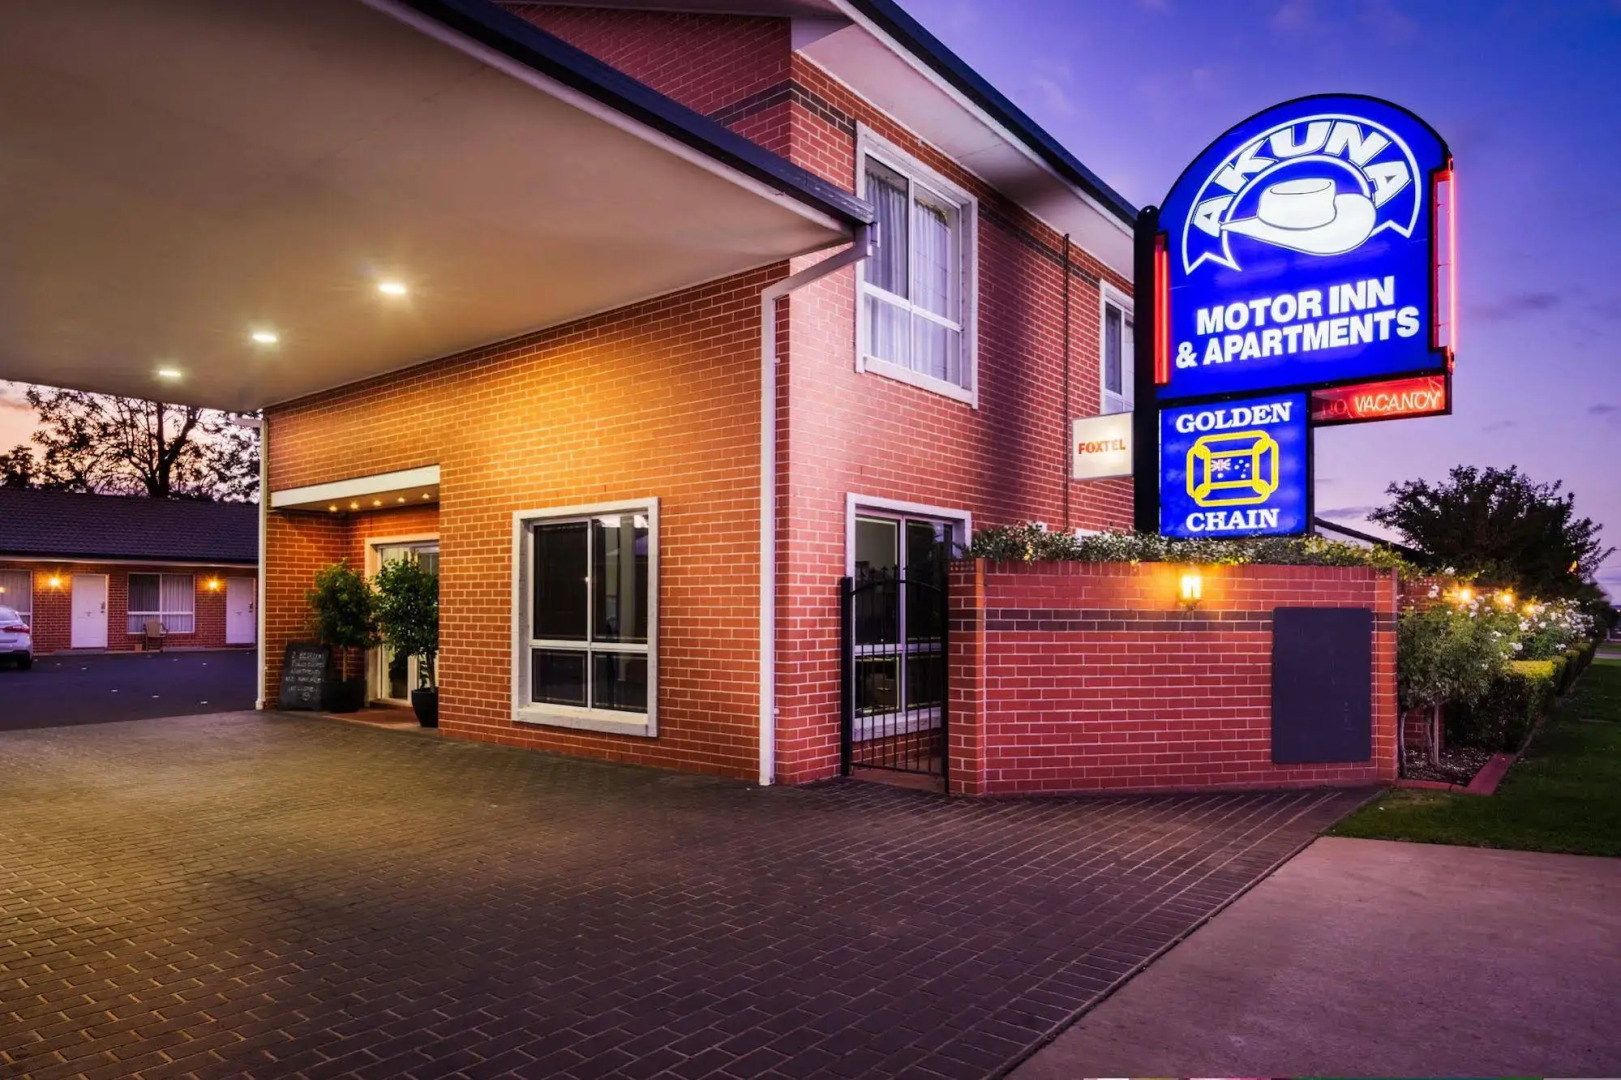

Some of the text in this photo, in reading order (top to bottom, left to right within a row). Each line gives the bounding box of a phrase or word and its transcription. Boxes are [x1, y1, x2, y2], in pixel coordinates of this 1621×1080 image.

[1191, 119, 1412, 237] AKUNA
[1196, 275, 1395, 336] MOTOR INN
[1175, 306, 1420, 369] & APARTMENTS
[1175, 401, 1293, 434] GOLDEN
[1354, 390, 1441, 413] VACANCY
[1078, 439, 1126, 455] FOXTEL
[1185, 508, 1280, 532] CHAIN
